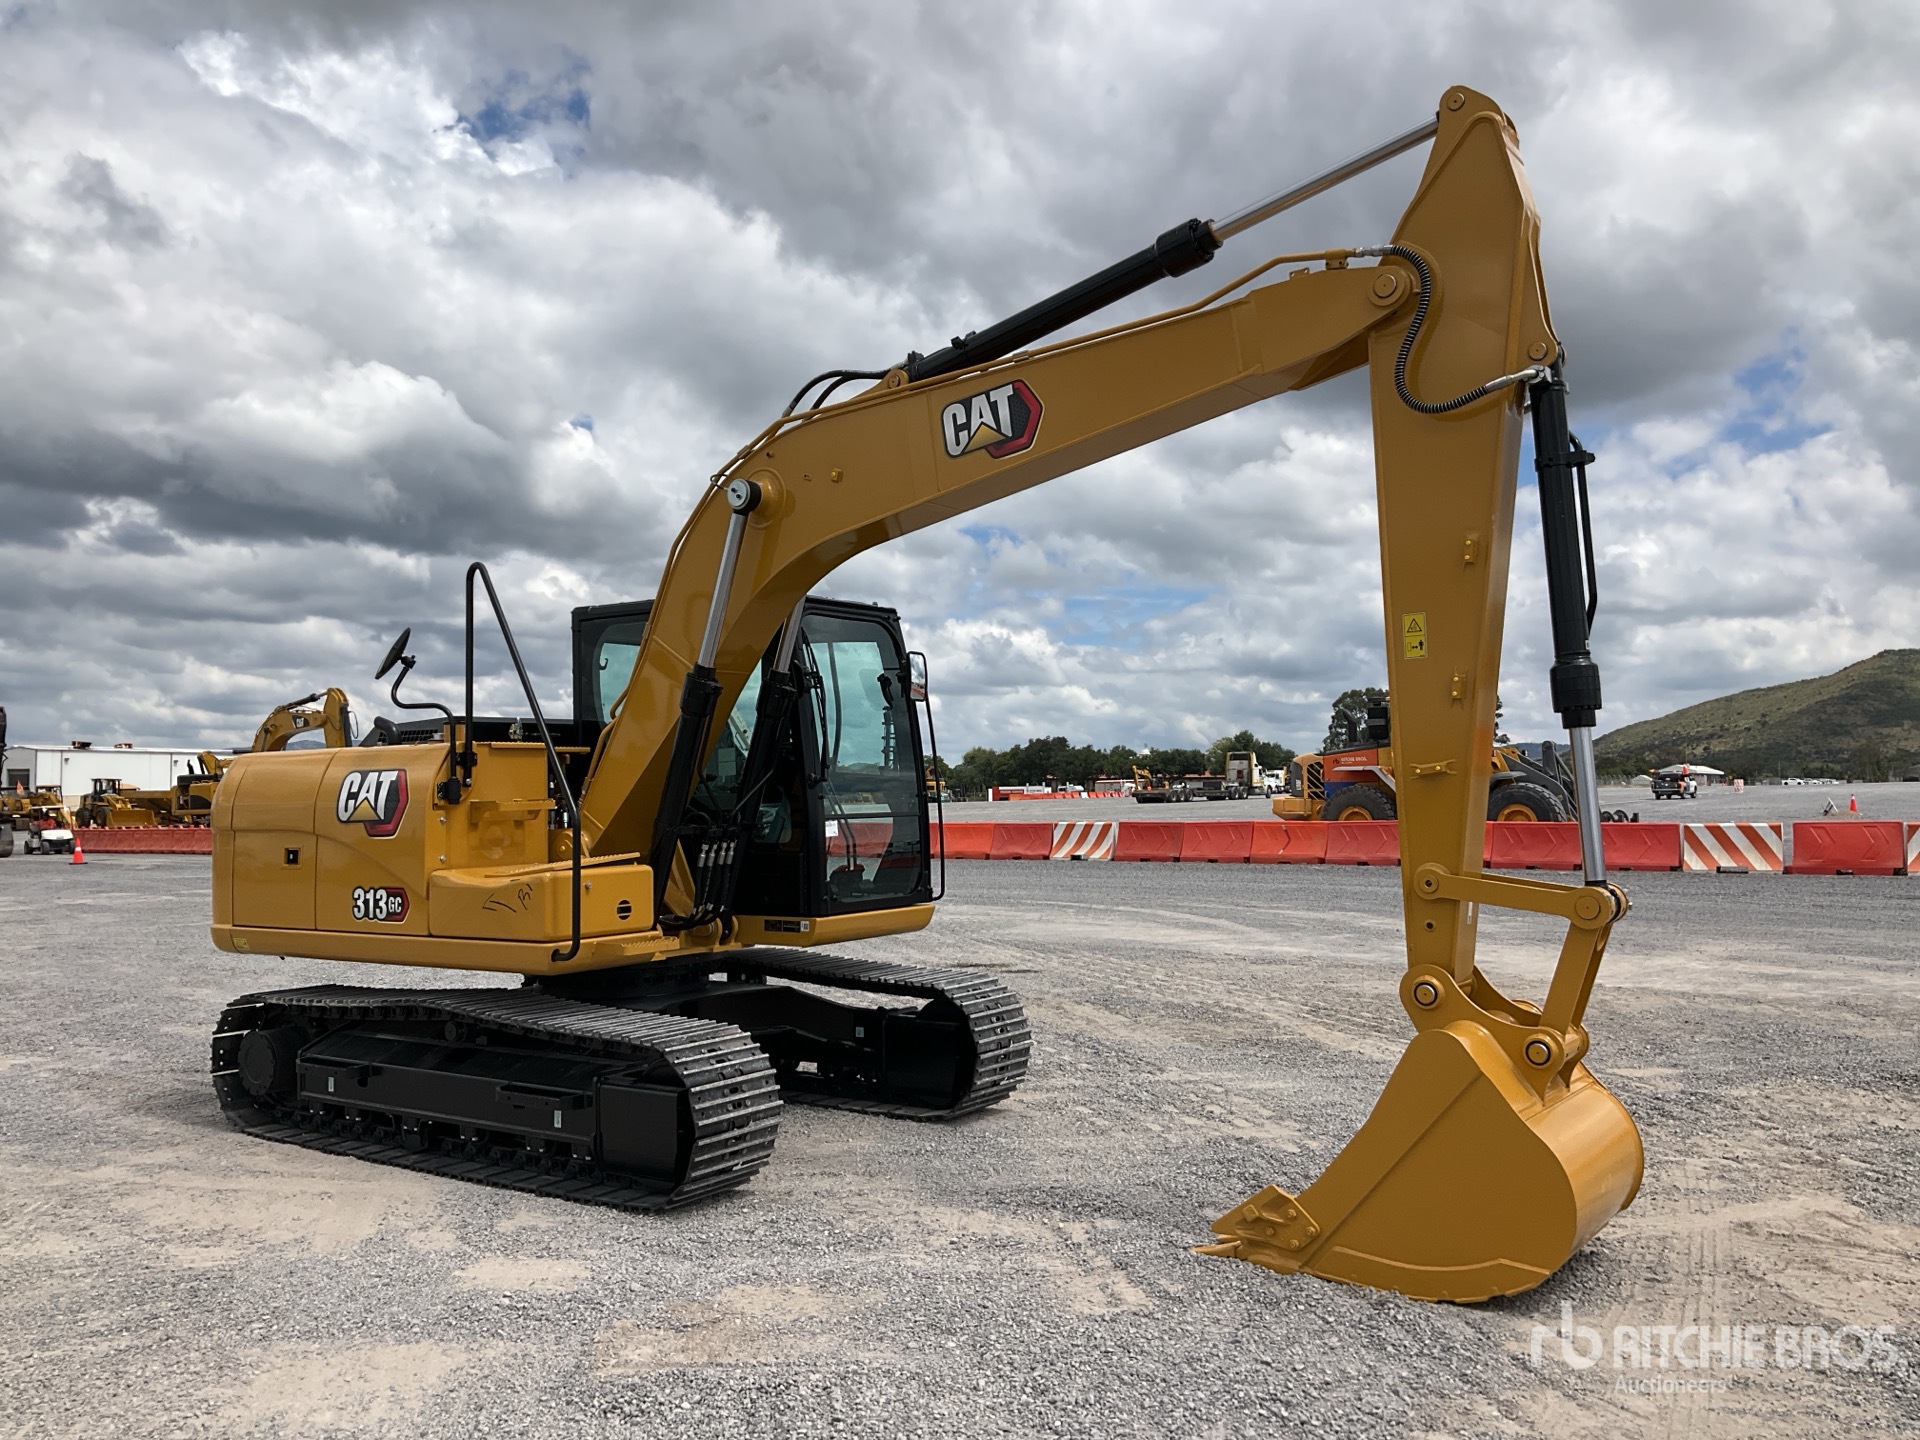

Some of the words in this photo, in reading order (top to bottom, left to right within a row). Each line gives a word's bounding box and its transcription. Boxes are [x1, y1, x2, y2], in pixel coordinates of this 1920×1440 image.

[942, 383, 1014, 457] CAT
[338, 770, 399, 822] CAT
[353, 888, 388, 920] 313
[388, 896, 402, 913] GC
